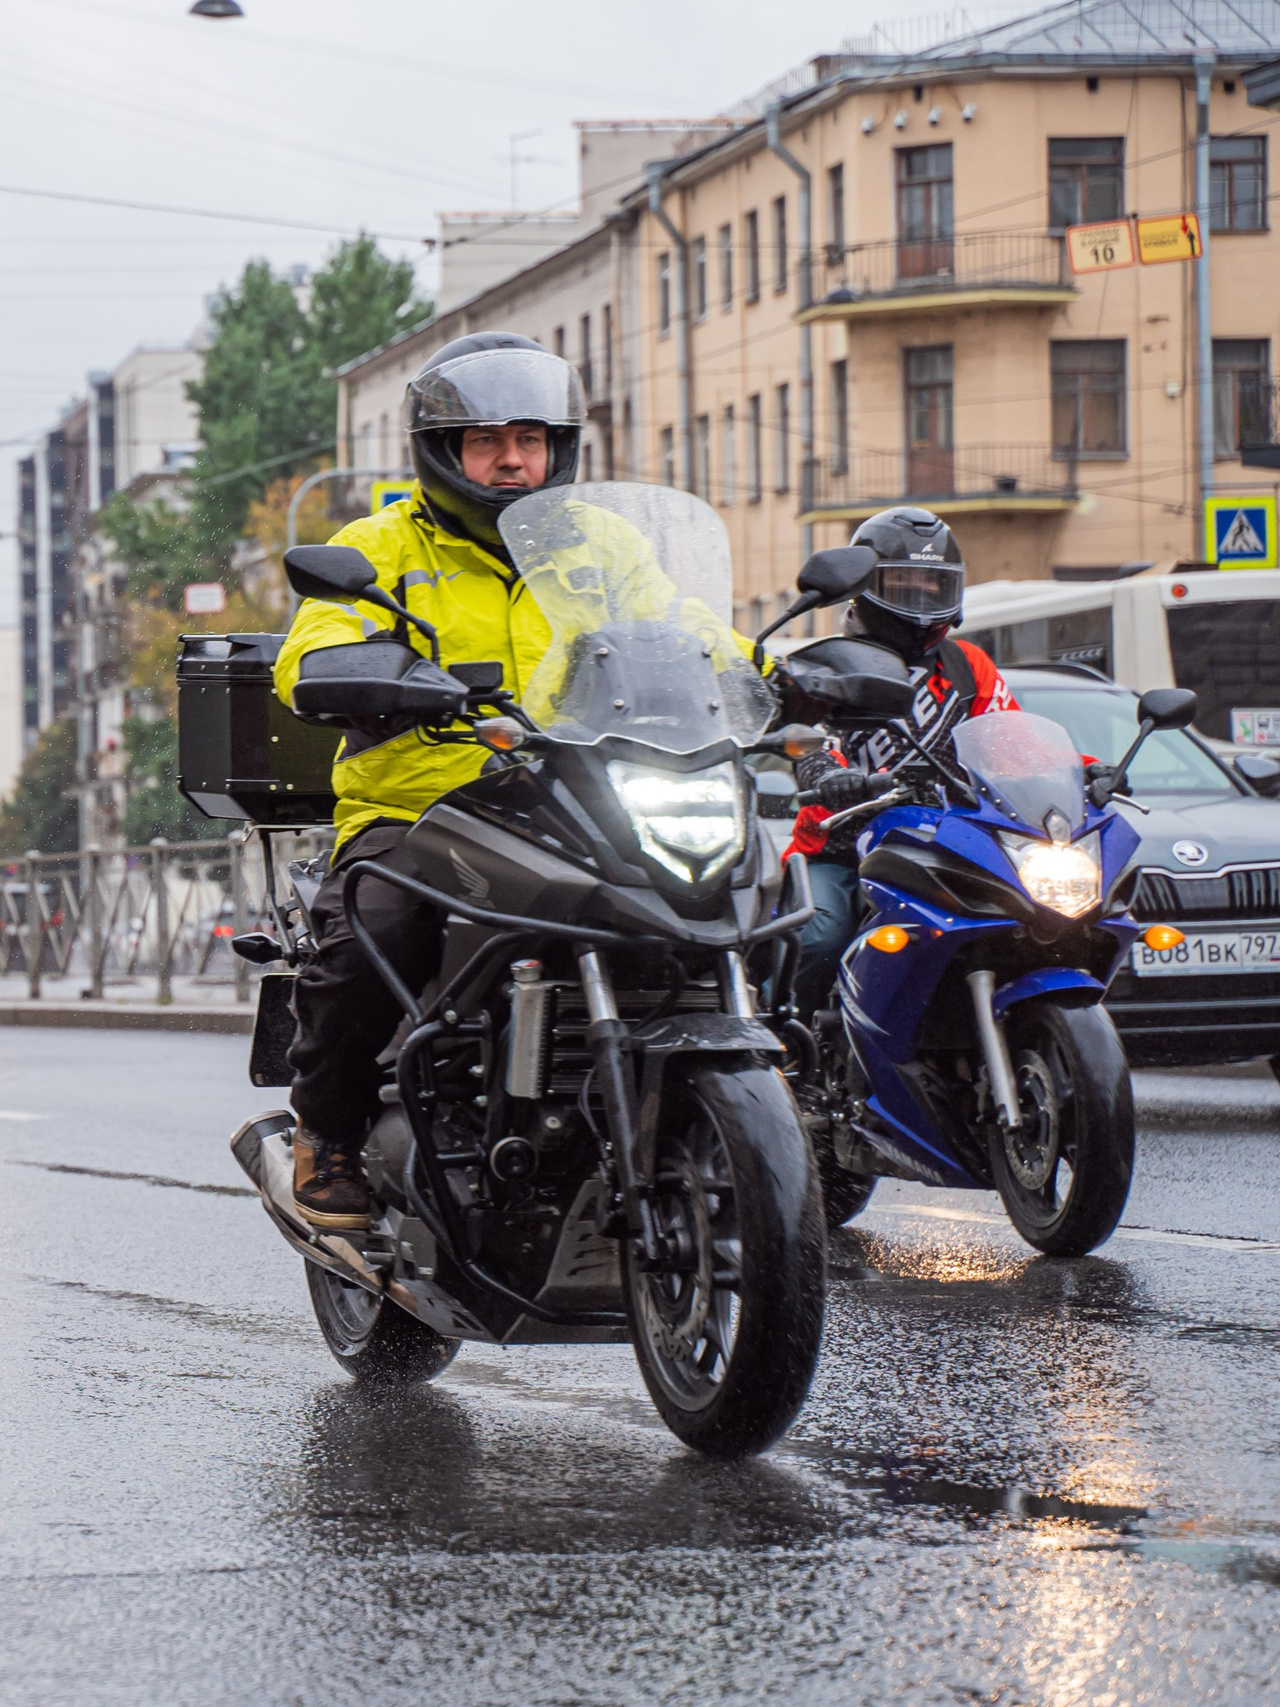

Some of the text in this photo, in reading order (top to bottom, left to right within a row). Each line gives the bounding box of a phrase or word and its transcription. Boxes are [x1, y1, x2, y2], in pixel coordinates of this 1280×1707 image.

[1091, 245, 1115, 264] 10
[909, 553, 945, 562] SHARK
[1242, 936, 1277, 954] 797
